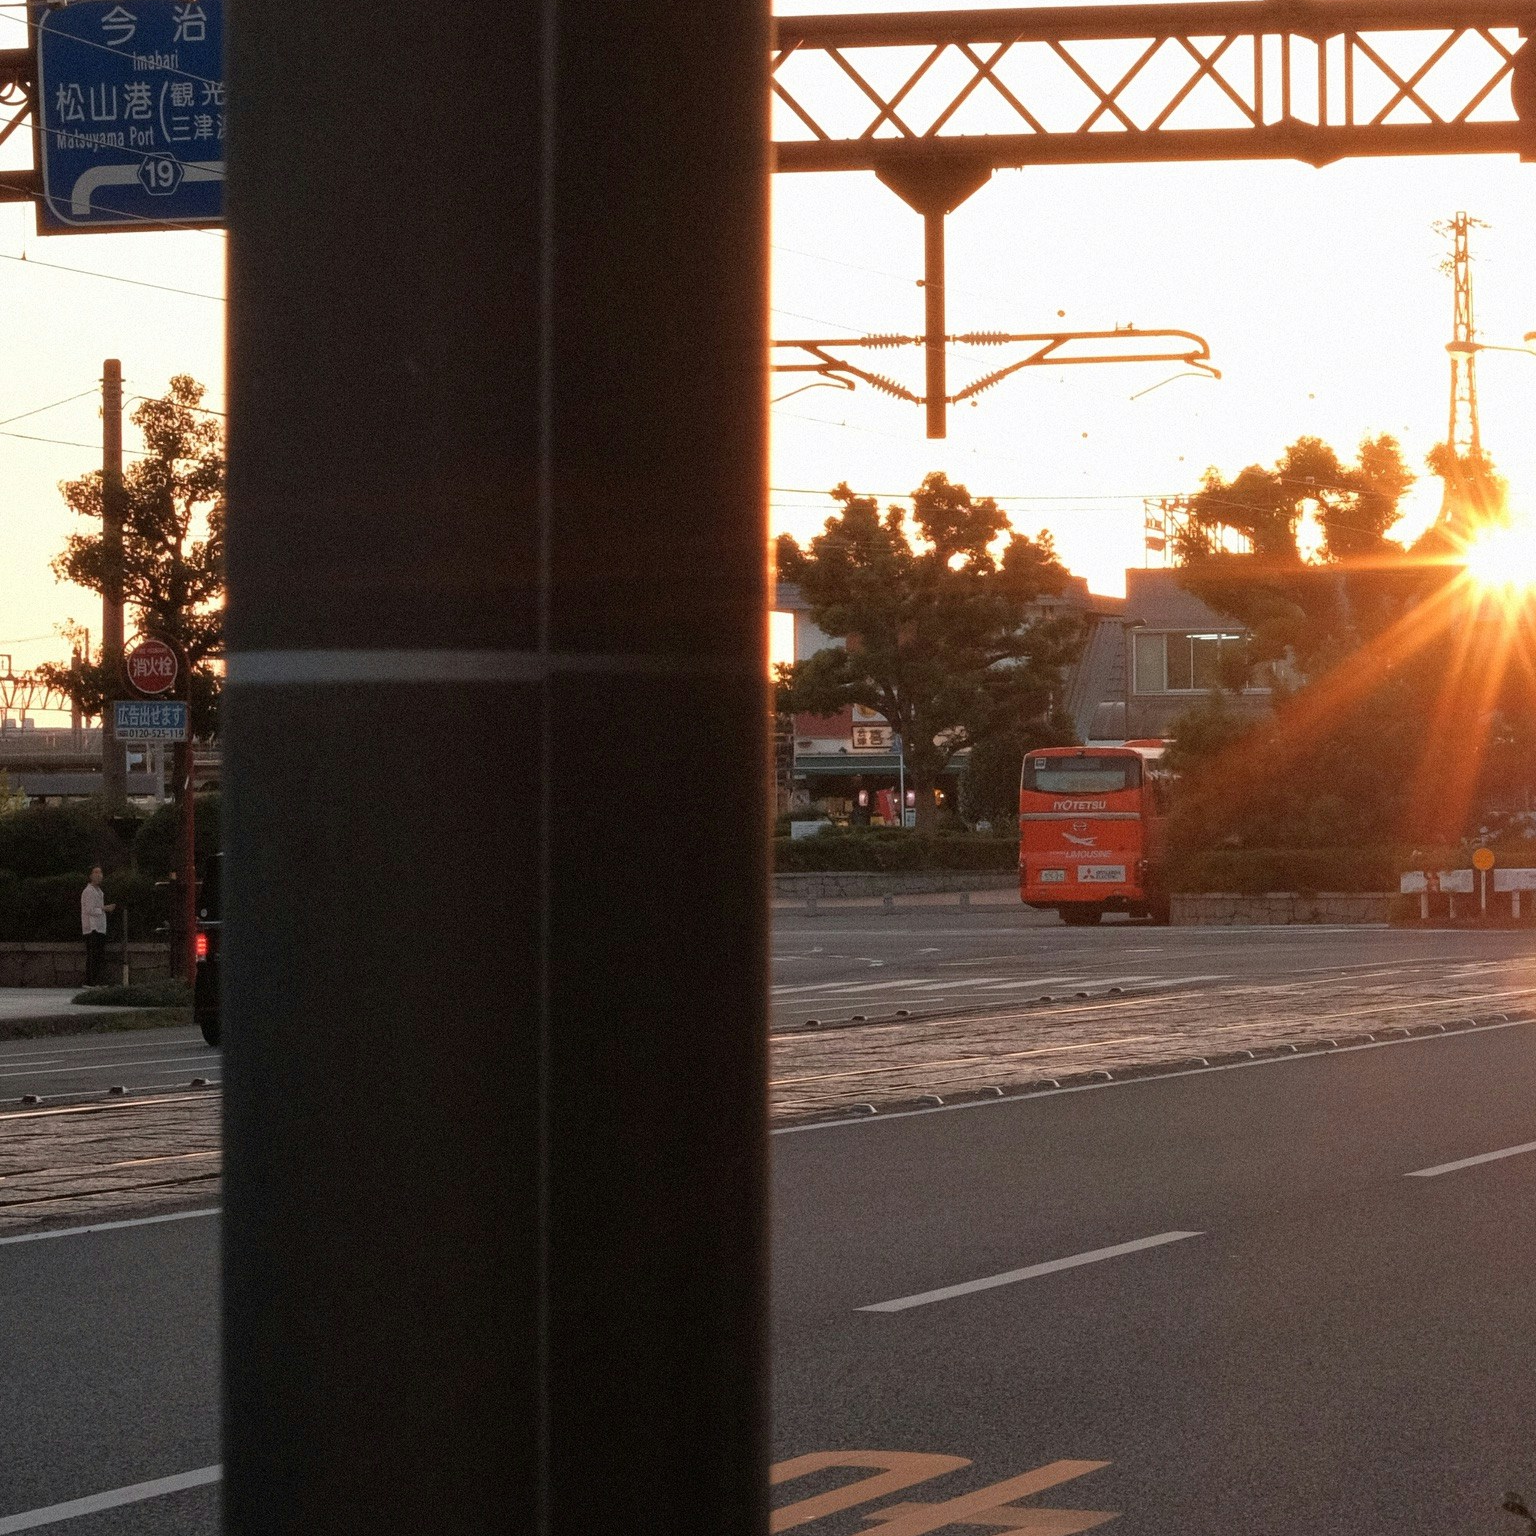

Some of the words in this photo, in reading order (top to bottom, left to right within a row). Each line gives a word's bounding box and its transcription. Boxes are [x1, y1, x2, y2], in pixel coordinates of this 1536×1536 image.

[101, 5, 207, 46] 今治
[133, 49, 179, 70] Imabari
[56, 82, 152, 123] 松山港
[57, 129, 125, 153] Matsuyama
[130, 126, 154, 147] Port
[146, 161, 174, 188] 19
[133, 656, 173, 678] 消火栓
[118, 705, 183, 726] 広告出せます
[129, 728, 184, 739] 0120-525-119
[1053, 800, 1107, 811] IYOTETSU
